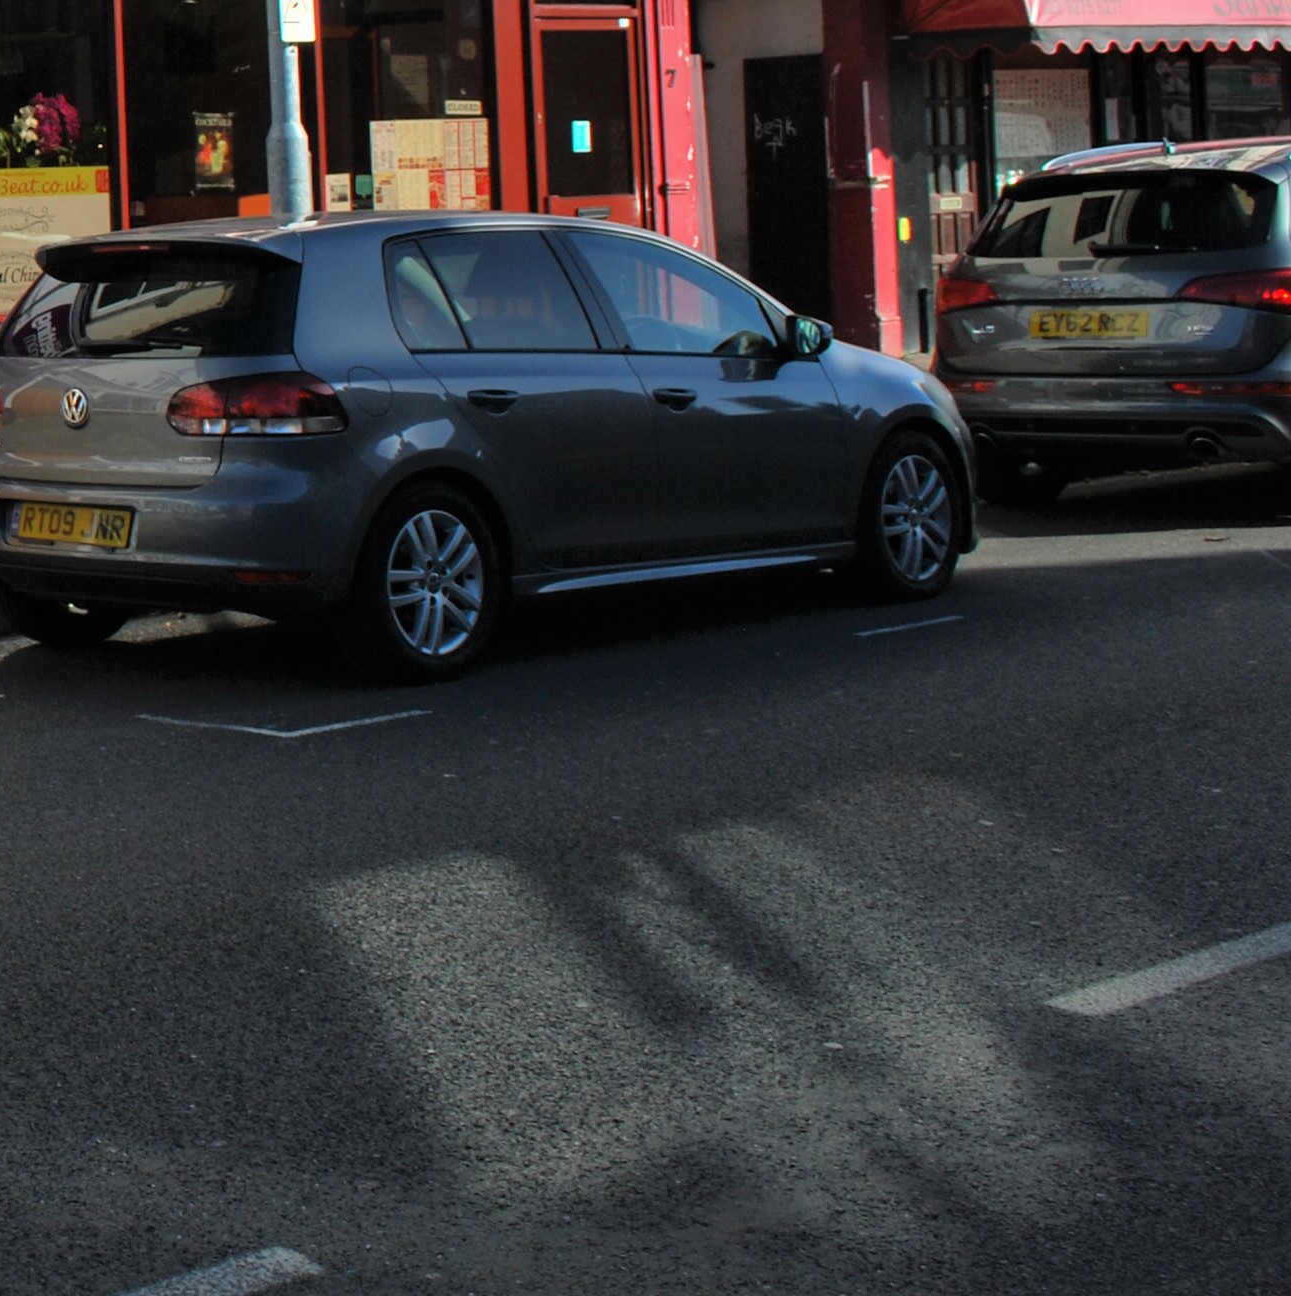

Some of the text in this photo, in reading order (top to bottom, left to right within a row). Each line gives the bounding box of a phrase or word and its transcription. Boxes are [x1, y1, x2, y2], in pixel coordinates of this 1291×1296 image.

[665, 69, 676, 88] 7
[1038, 313, 1093, 333] EY62
[22, 505, 76, 536] RT09
